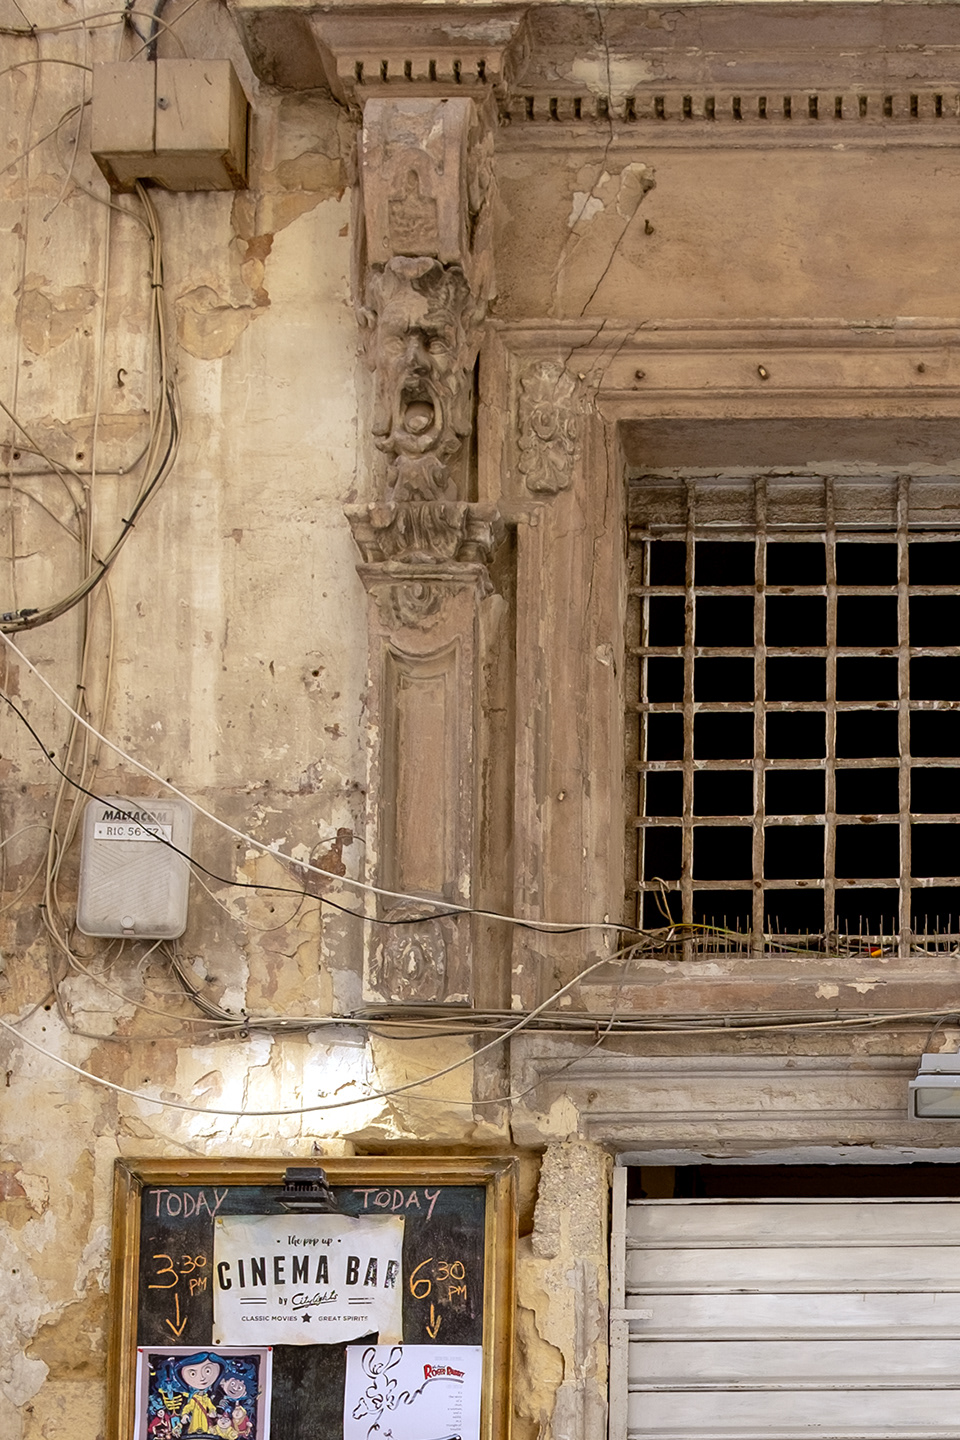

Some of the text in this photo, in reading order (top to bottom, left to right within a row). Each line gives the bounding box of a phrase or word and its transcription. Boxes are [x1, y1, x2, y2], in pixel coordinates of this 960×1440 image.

[101, 810, 167, 822] MALTACOM
[149, 1188, 229, 1225] TODAY
[352, 1188, 442, 1221] TODAY
[287, 1234, 333, 1247] The pop up
[216, 1255, 400, 1291] CINEMA BAR
[189, 1277, 208, 1296] PM
[448, 1285, 467, 1302] PM
[278, 1296, 288, 1306] by
